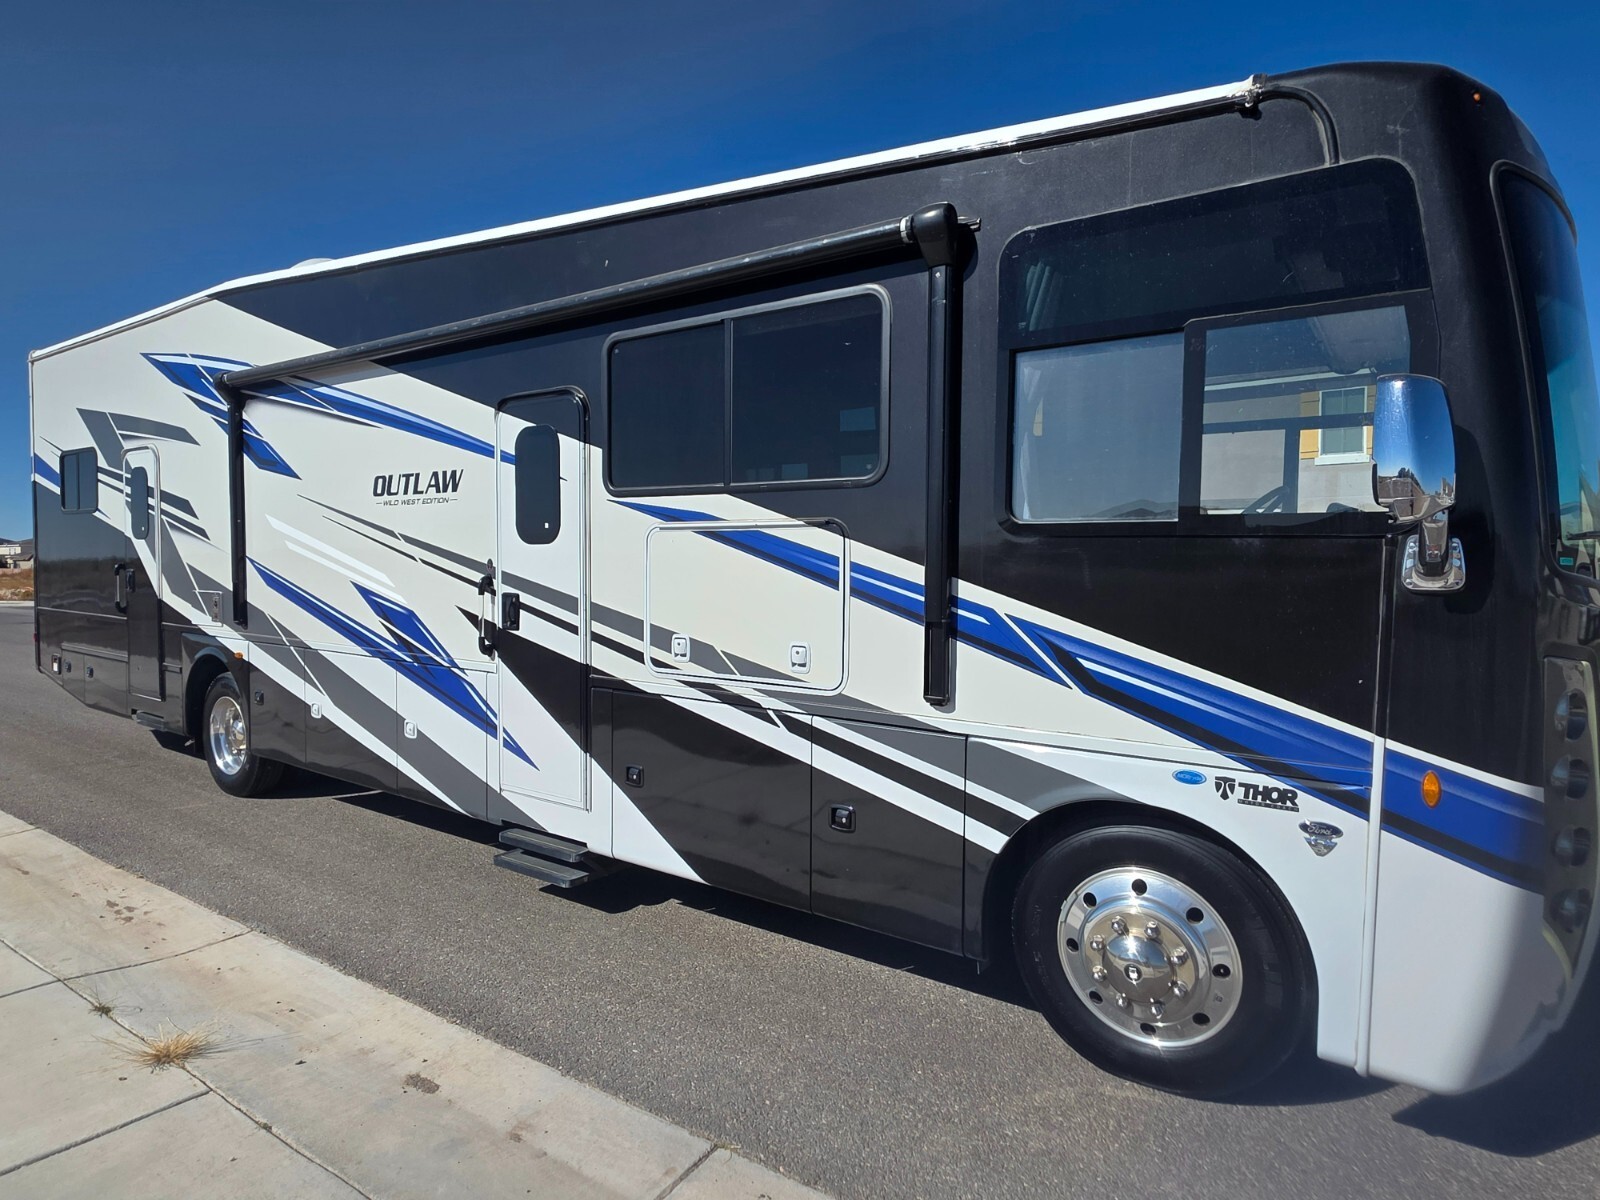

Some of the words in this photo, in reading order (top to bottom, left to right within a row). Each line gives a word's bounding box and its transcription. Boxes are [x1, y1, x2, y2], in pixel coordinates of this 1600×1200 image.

[373, 469, 464, 497] OUTLAW
[401, 498, 421, 506] WEST
[1238, 782, 1299, 807] THOR
[1307, 823, 1333, 835] Ford
